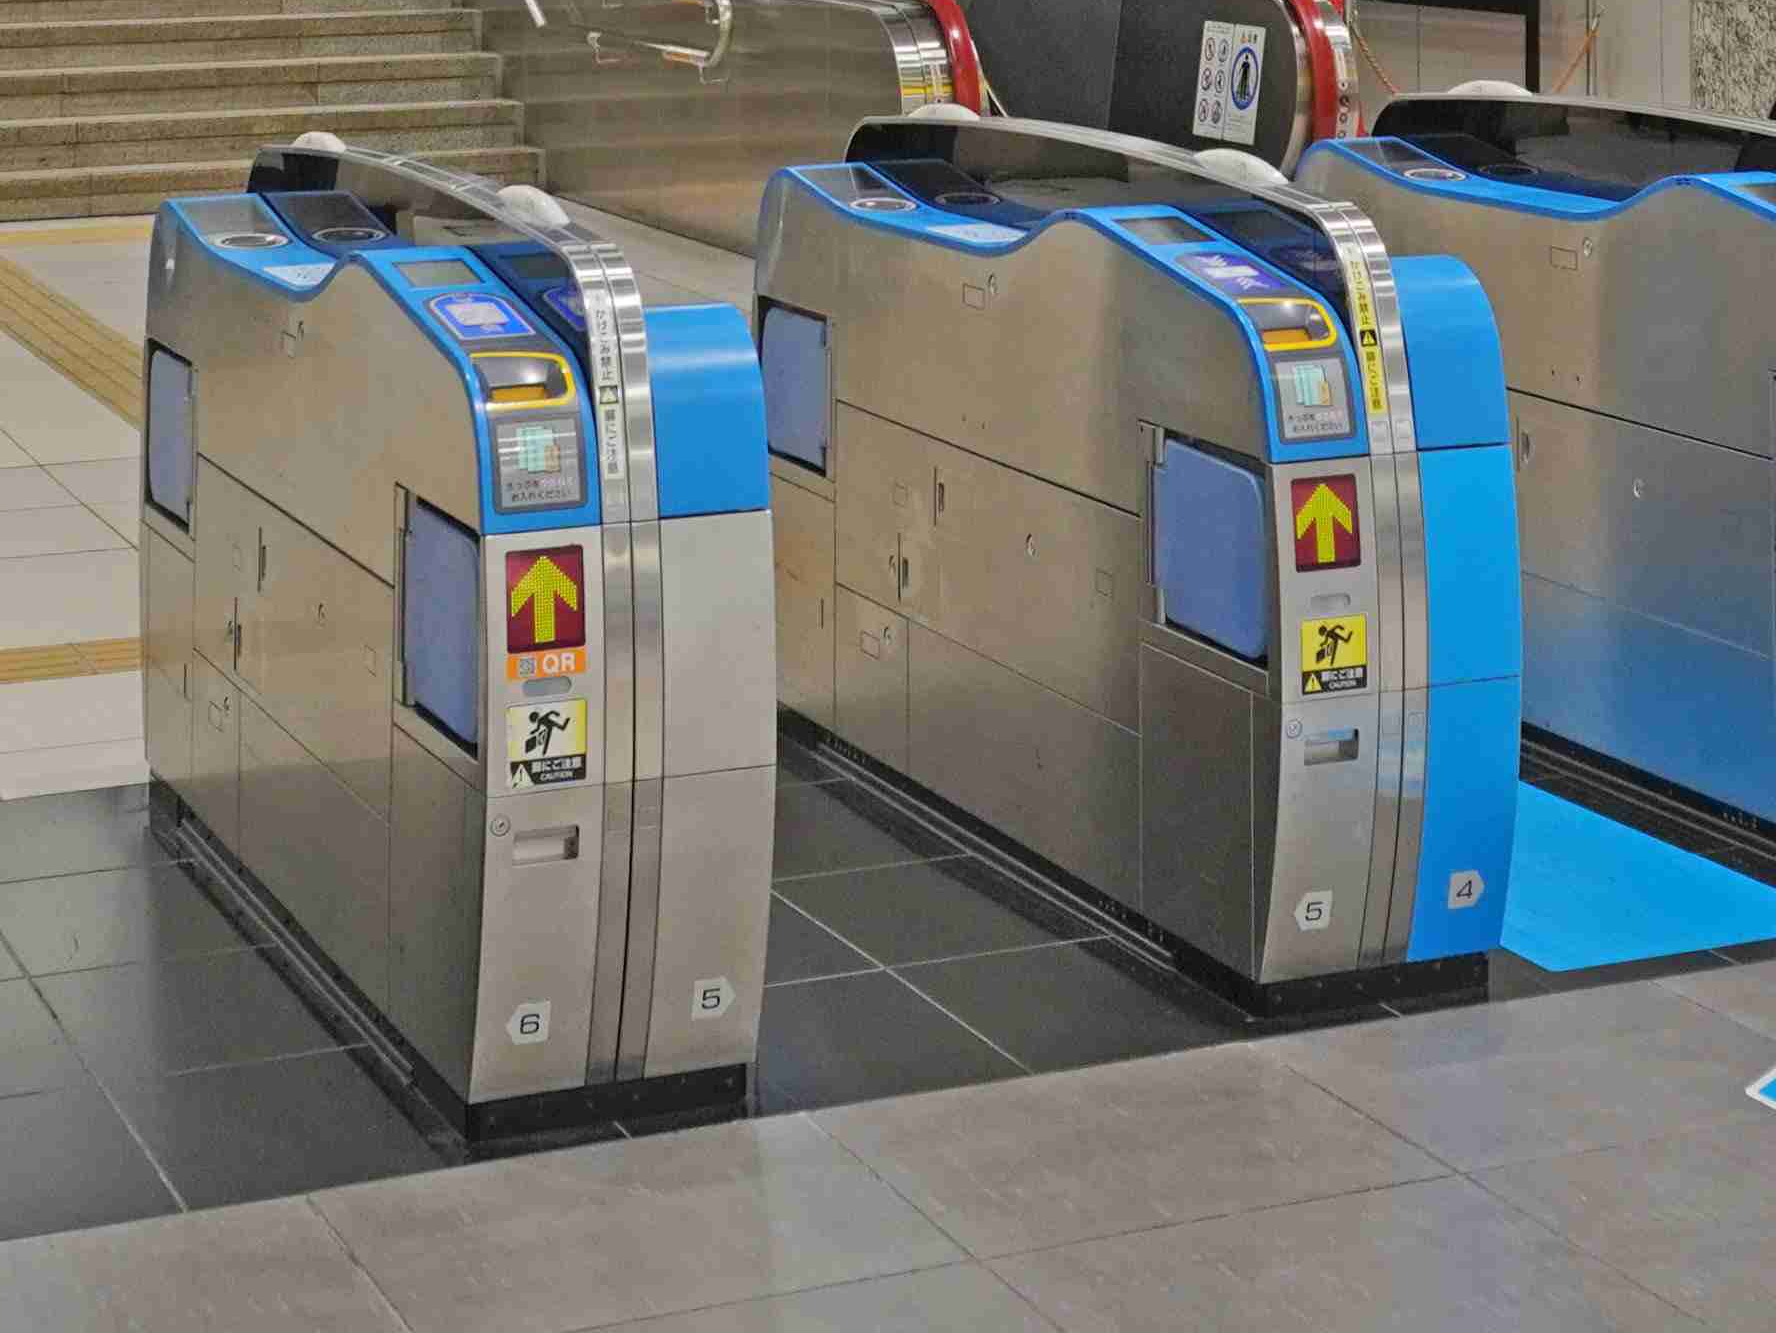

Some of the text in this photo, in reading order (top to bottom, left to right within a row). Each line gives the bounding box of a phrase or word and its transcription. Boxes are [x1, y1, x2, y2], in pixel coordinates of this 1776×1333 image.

[544, 652, 576, 673] QR
[1454, 880, 1474, 899] 4
[1305, 901, 1325, 921] 5
[700, 987, 722, 1012] 5
[518, 1012, 540, 1037] 6
